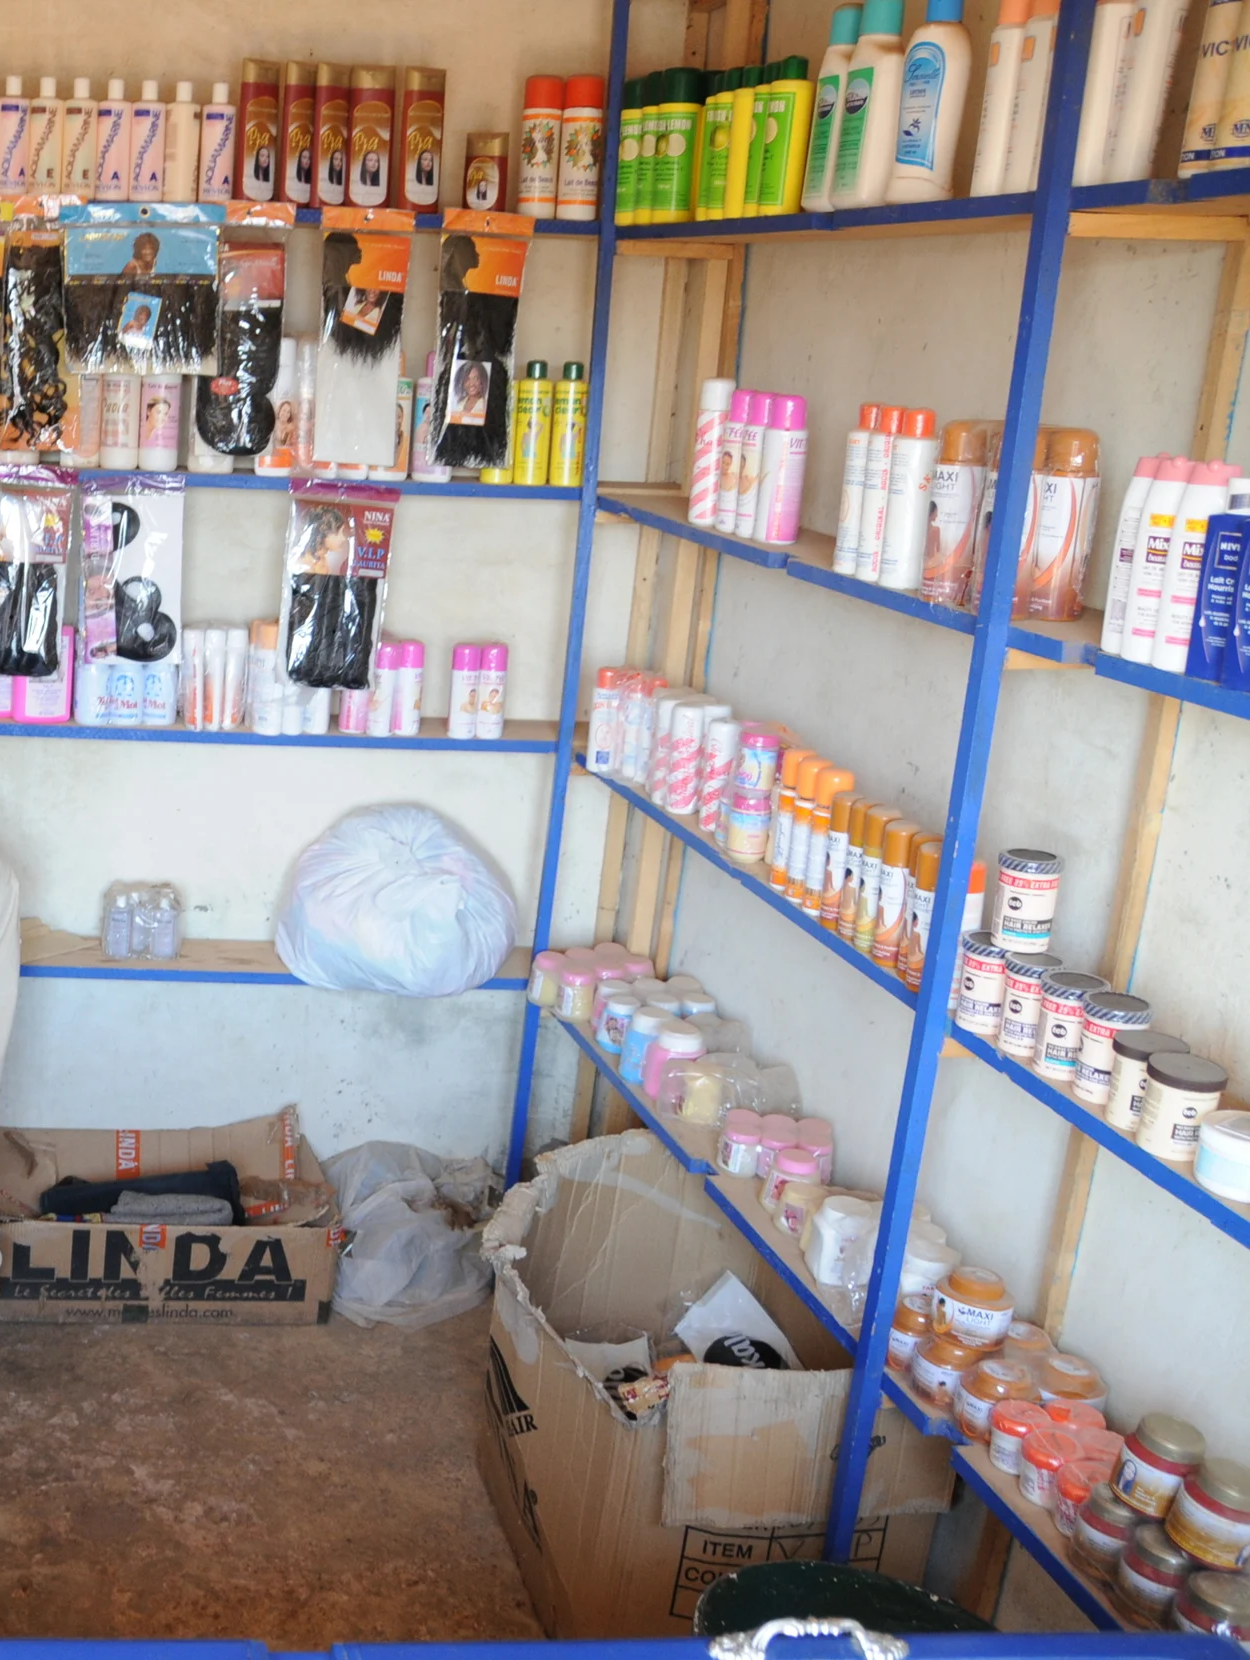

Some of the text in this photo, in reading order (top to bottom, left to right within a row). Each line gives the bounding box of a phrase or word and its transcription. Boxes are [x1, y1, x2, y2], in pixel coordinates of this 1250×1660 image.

[1, 105, 29, 178] AQUAMARINE
[30, 107, 58, 180] AQUAMARINE
[64, 107, 93, 181] AQUAMARINE
[96, 109, 124, 183] AQUAMARINE
[132, 110, 162, 183] AQUAMARINE
[204, 113, 235, 187] AQUAMARINE
[378, 270, 402, 283] LINDA
[495, 274, 517, 287] LINDA
[1149, 537, 1170, 551] Mix
[1223, 554, 1239, 562] bod
[1030, 879, 1050, 890] EXTRA
[1004, 921, 1022, 930] HAIR
[1081, 1067, 1111, 1081] RELAXE
[11, 1229, 294, 1284] LINDA
[966, 1308, 994, 1321] MAXI
[505, 1411, 539, 1438] AIR
[702, 1539, 754, 1561] ITEM
